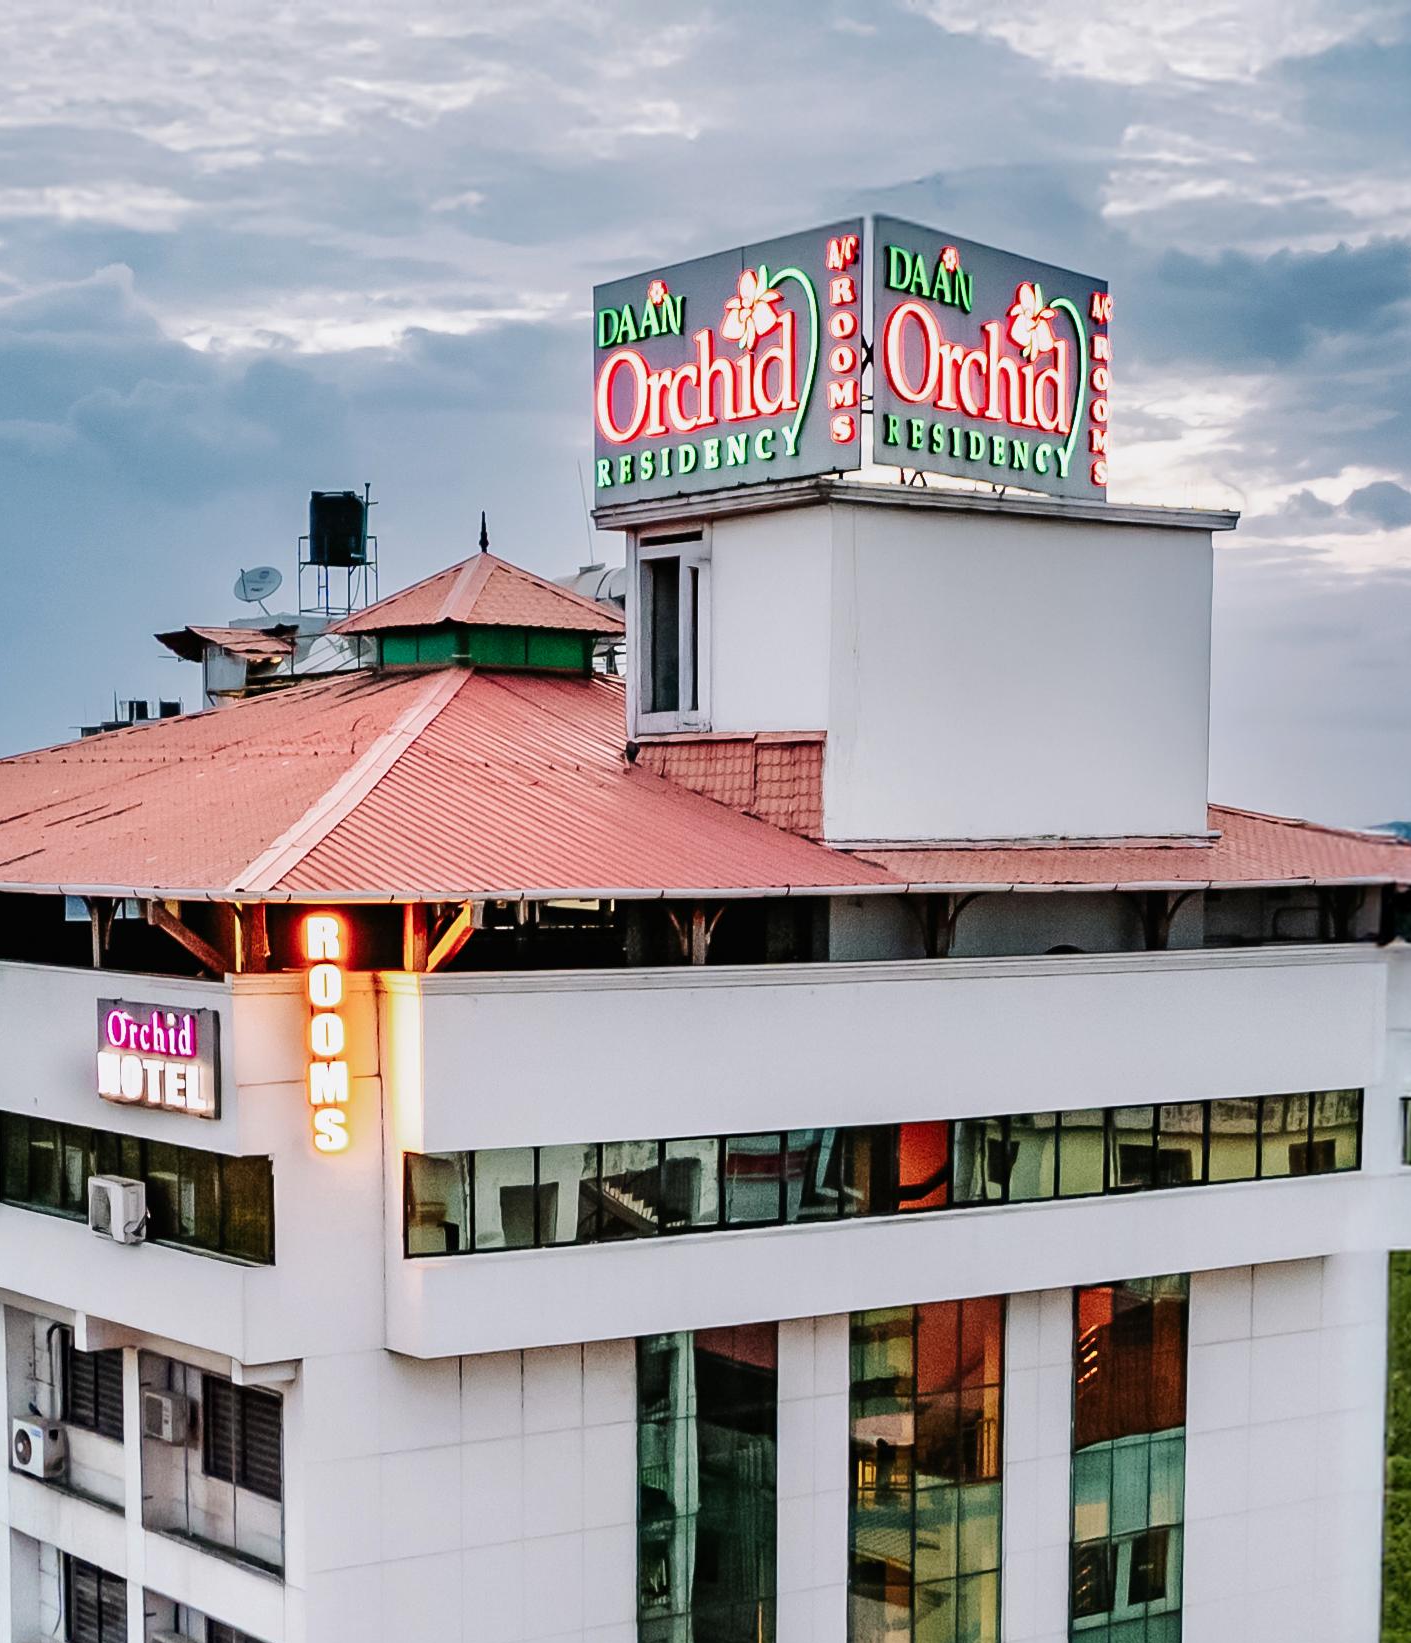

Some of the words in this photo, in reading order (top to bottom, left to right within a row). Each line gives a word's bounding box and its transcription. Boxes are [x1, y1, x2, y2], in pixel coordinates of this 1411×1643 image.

[827, 236, 858, 271] A/C
[597, 311, 799, 445] Orchid
[829, 276, 857, 444] ROOMS
[885, 302, 1070, 434] Orchid
[597, 427, 798, 488] RESIDENCY
[887, 414, 1070, 478] RESIDENCY
[1090, 333, 1112, 486] ROOMS
[97, 1052, 208, 1111] HOTEL
[107, 1010, 195, 1056] Orchid
[307, 916, 348, 1151] ROOMS
